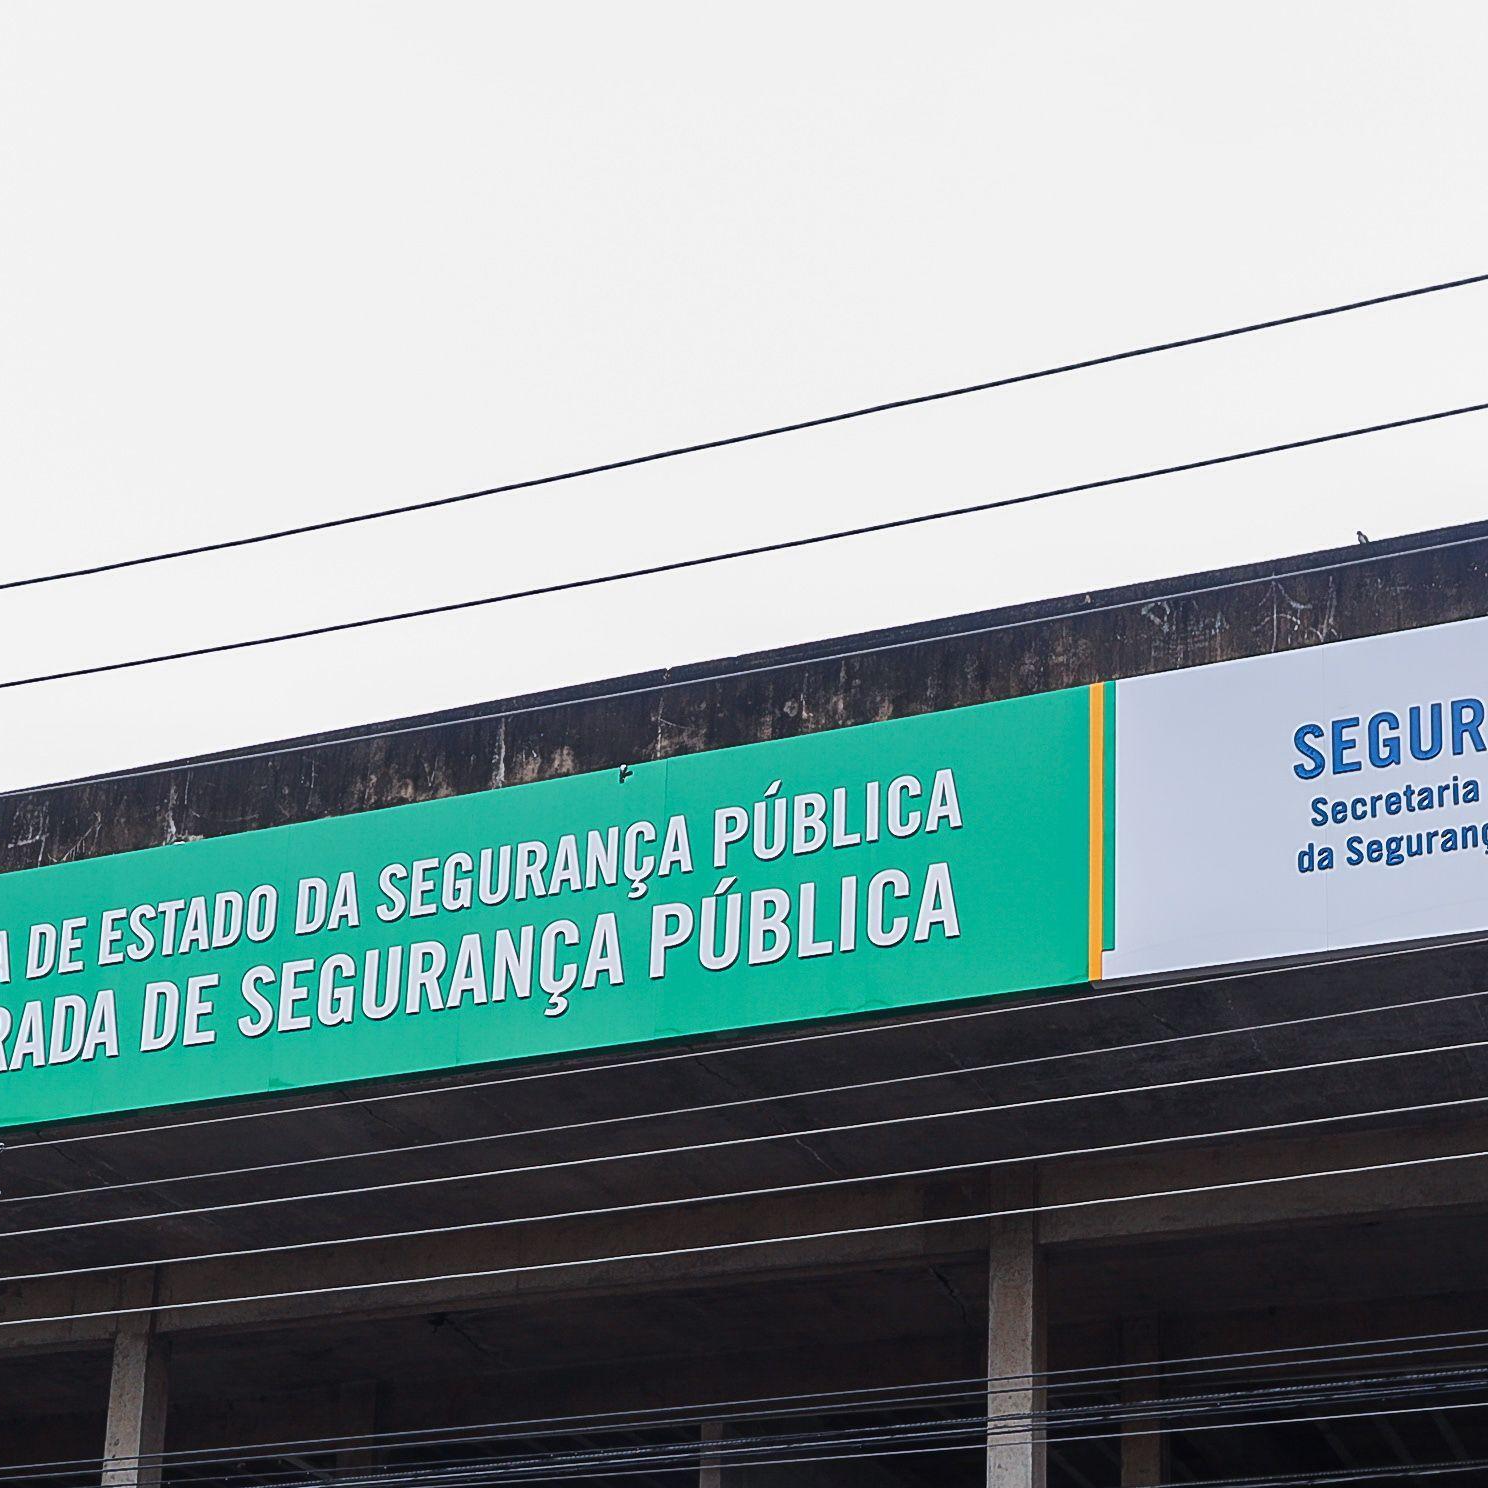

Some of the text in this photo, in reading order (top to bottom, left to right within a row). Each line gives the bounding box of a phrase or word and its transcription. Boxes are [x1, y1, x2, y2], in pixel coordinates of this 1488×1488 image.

[1297, 842, 1335, 874] da
[1311, 775, 1480, 827] Secretaria
[25, 917, 87, 980] DE
[96, 882, 278, 962] ESTADO
[293, 870, 360, 936] DA
[375, 814, 694, 900] SEGURANÇA
[711, 768, 964, 869] PÚBLICA
[137, 972, 220, 1053] DE
[236, 911, 625, 1018] SEGURANÇA
[648, 860, 962, 980] PÚBLICA
